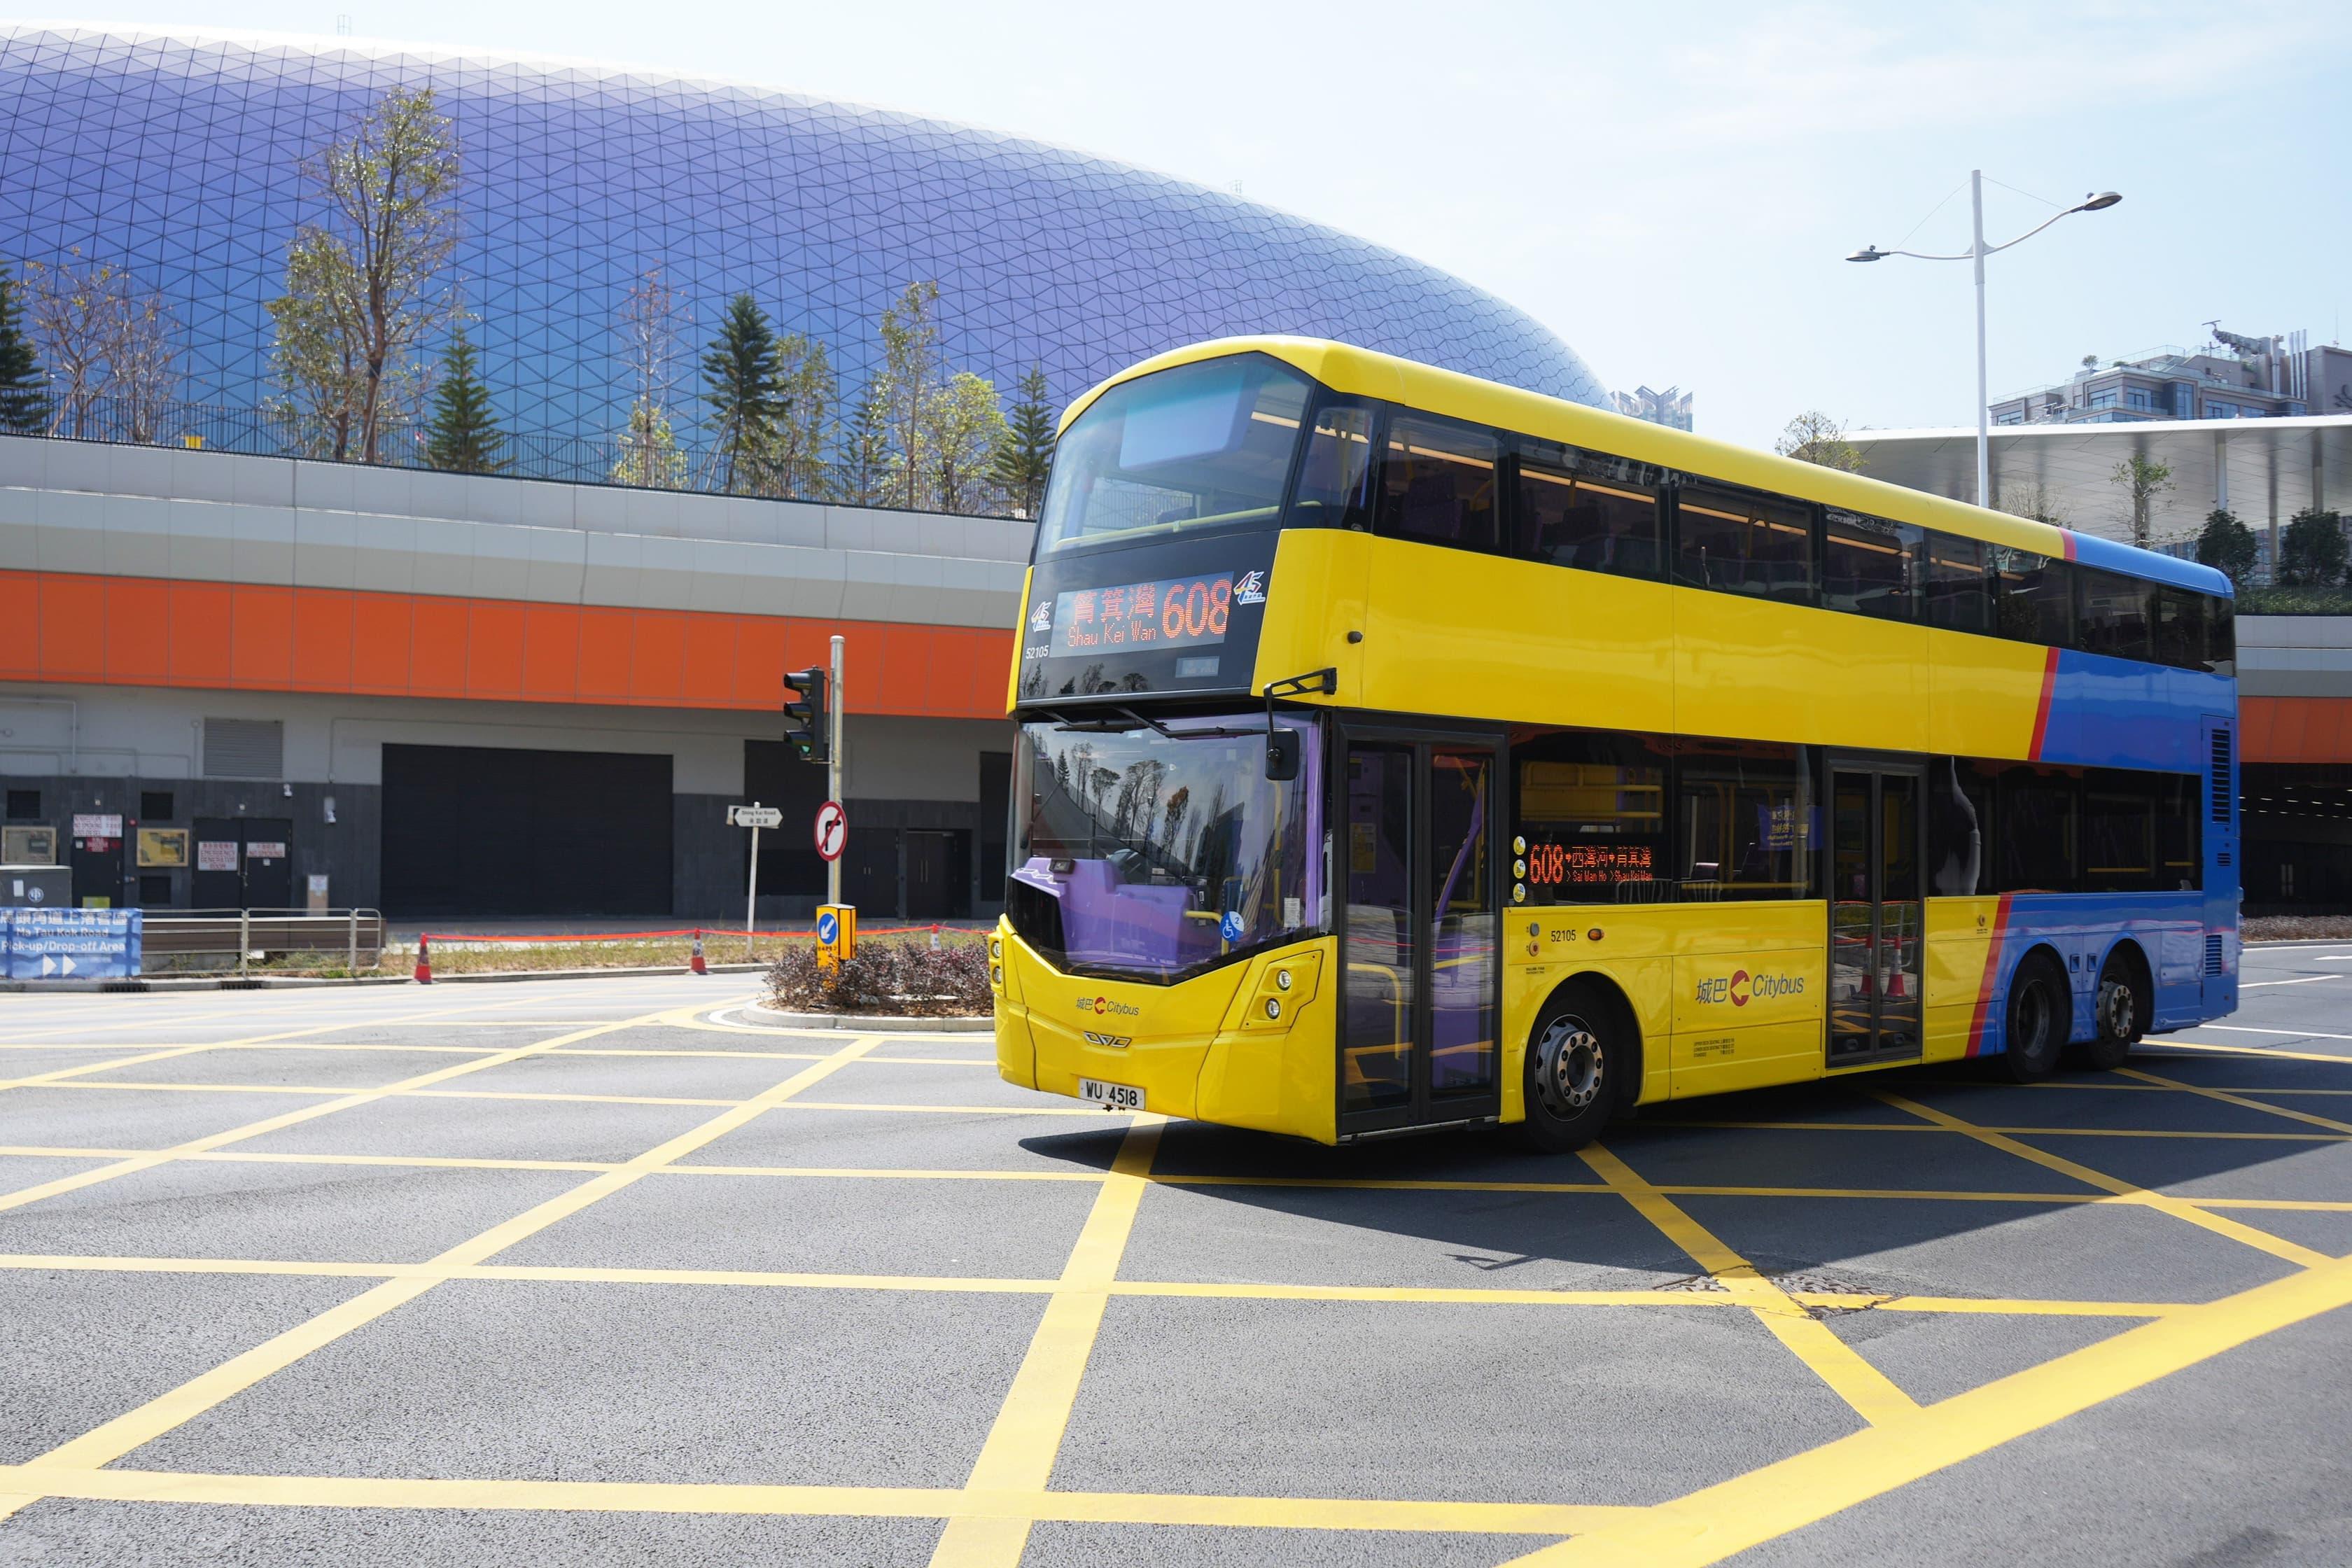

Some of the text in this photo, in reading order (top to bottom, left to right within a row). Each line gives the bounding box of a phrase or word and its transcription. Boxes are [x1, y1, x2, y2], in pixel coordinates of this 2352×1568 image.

[1074, 583, 1156, 624] 筲箕灣
[1162, 579, 1232, 638] 608
[1068, 620, 1156, 648] Shau Kei Wan
[1026, 645, 1049, 659] 52105
[1530, 844, 1564, 883] 608
[1573, 870, 1607, 882] Sai Wan Ho
[16, 927, 109, 937] Ma Tau Kok Road
[1550, 930, 1576, 942] 52105
[1, 940, 126, 953] Pick-up/Drop-off Area
[1695, 978, 1728, 1004] 城巴
[1753, 973, 1804, 999] Citybus
[1076, 997, 1093, 1011] 城巴
[1107, 1001, 1140, 1016] Citybus
[1086, 1082, 1138, 1106] WU 4518
